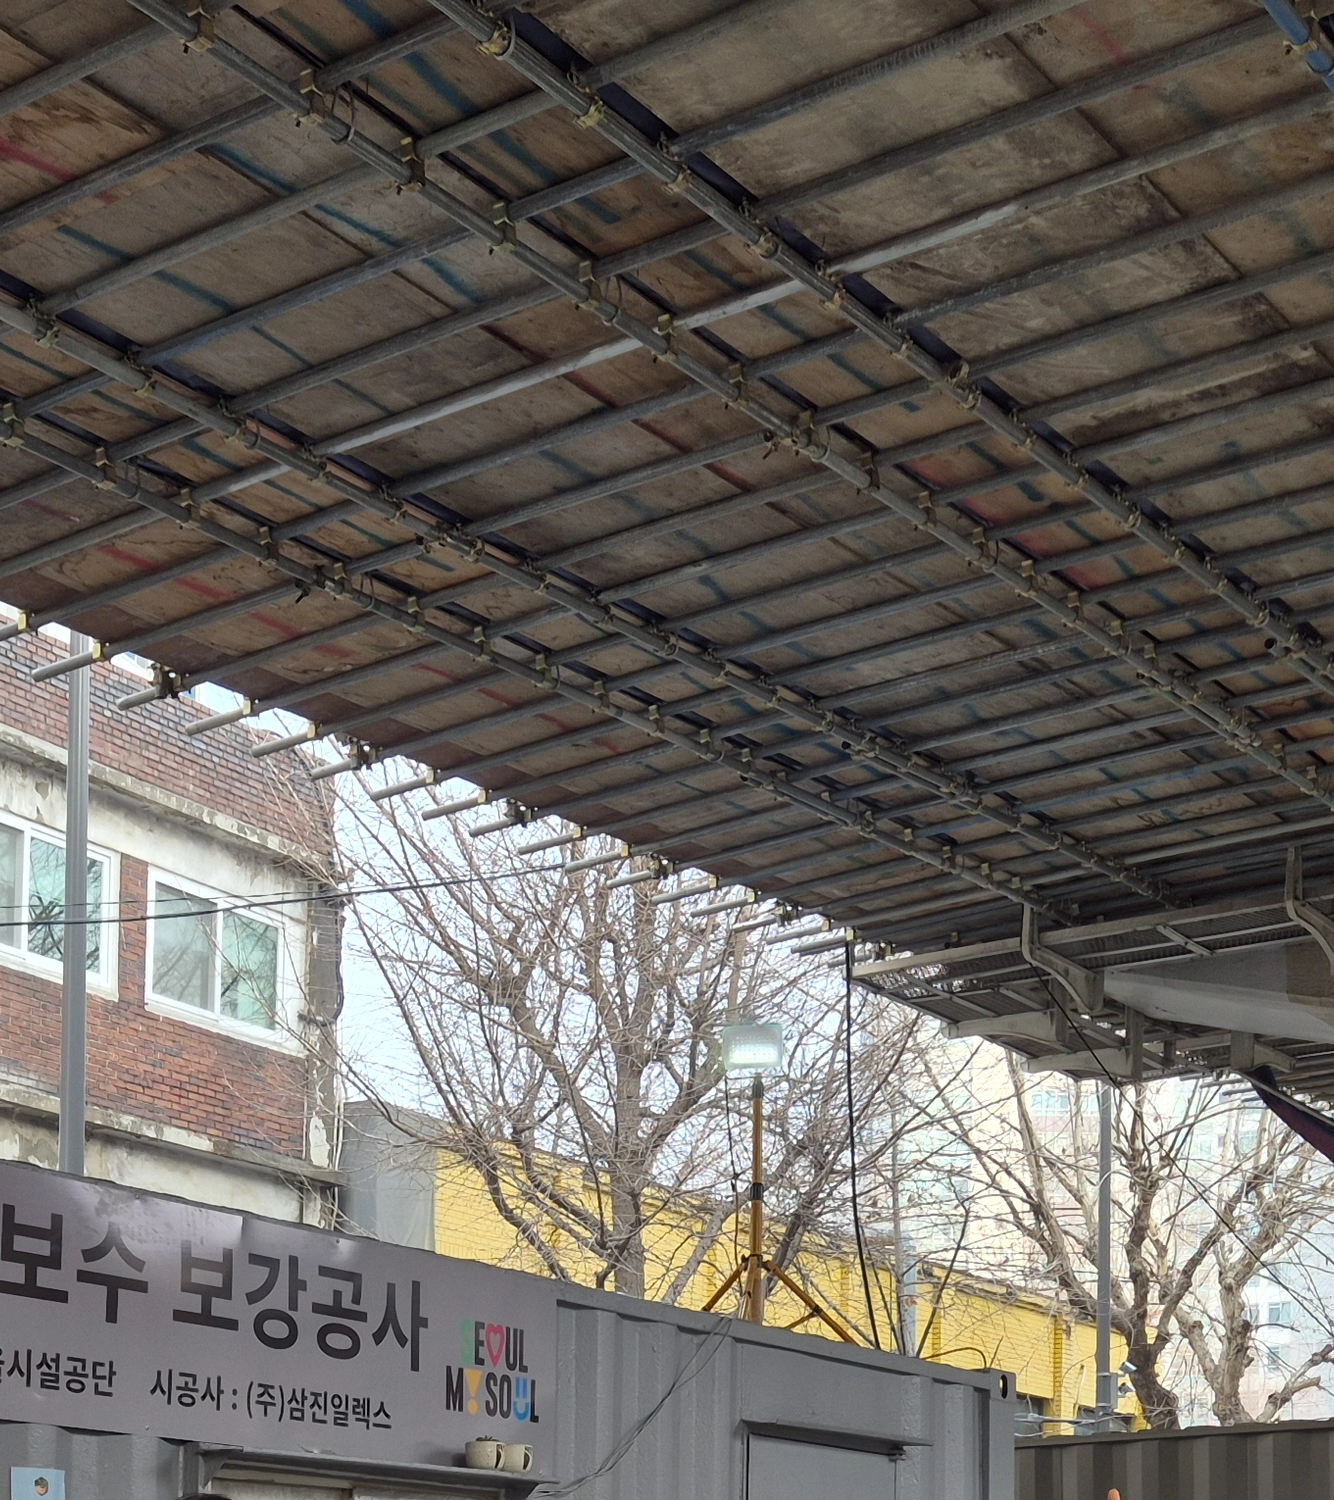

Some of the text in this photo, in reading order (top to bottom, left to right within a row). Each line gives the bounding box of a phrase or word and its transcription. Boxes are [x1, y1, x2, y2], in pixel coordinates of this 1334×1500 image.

[172, 1240, 429, 1372] 보강공사
[460, 1317, 528, 1374] SEOUL
[246, 1380, 393, 1430] (주)삼진일렉스
[485, 1371, 540, 1424] SOUL
